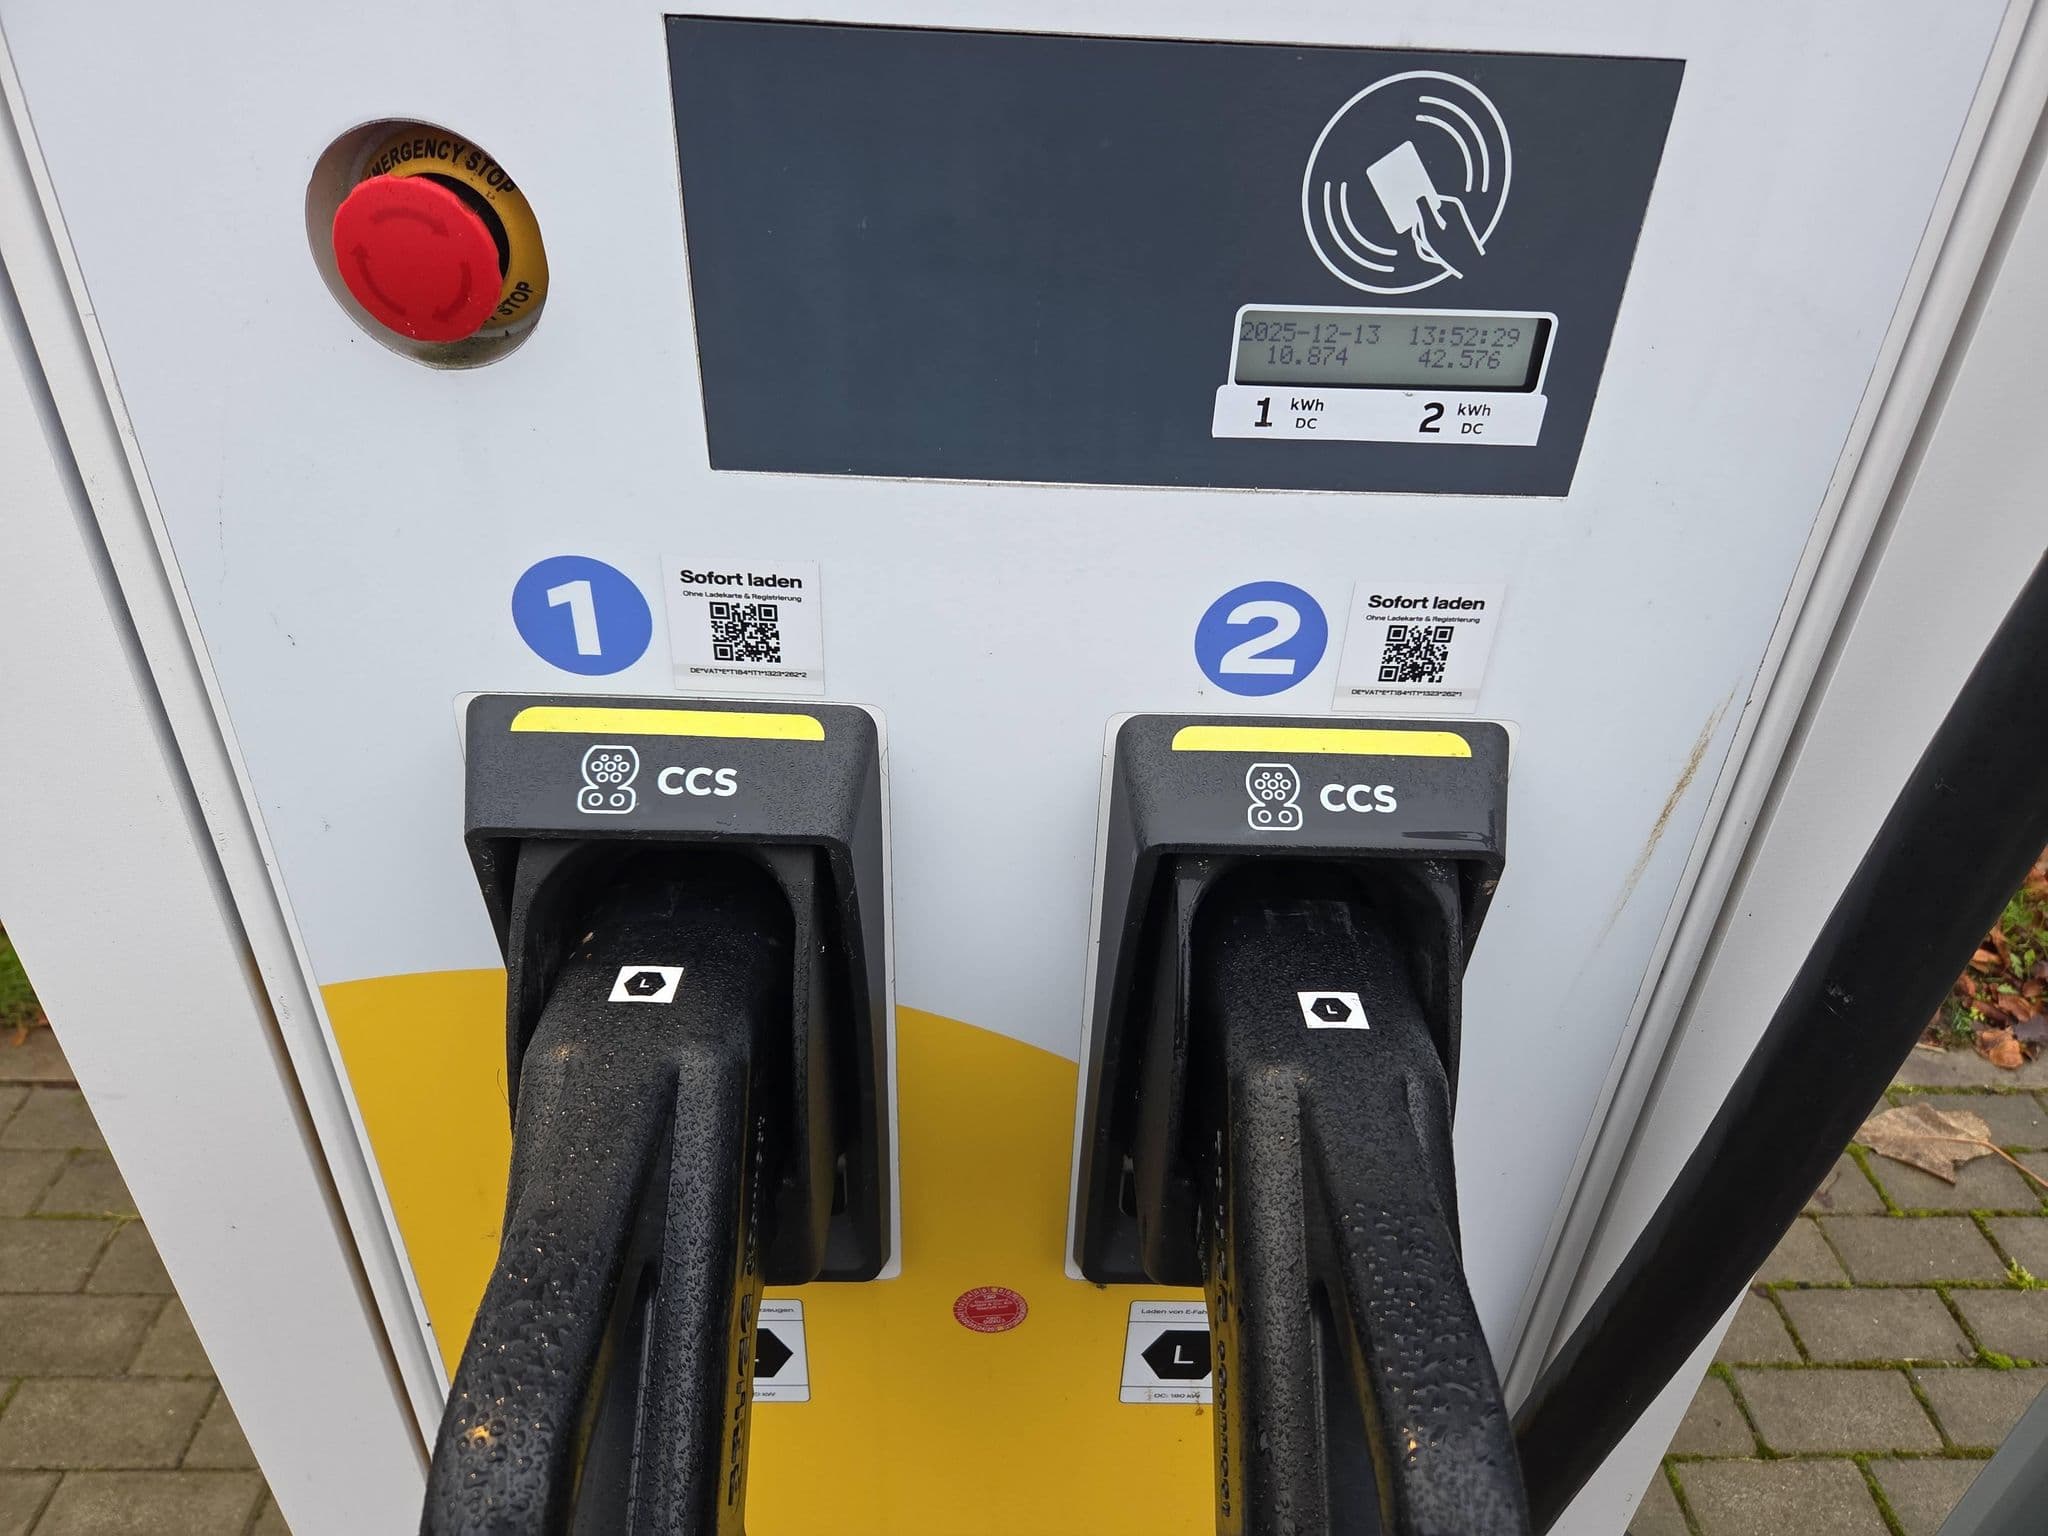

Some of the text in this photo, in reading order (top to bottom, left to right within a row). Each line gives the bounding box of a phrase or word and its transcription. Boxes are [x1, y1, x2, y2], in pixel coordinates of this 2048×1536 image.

[368, 138, 515, 193] MERGENCY STOP
[497, 281, 533, 315] STOP
[1240, 321, 1521, 348] 2025-12-13 13:52:29
[1267, 345, 1501, 369] 10.874 42.576
[1254, 397, 1273, 427] 1
[1290, 398, 1324, 411] kWh
[1457, 403, 1491, 416] kWh
[1295, 418, 1318, 430] DC
[1418, 401, 1445, 433] 2
[1461, 422, 1484, 434] DC
[680, 569, 803, 589] Sofort laden
[704, 591, 743, 599] Ladekarte
[751, 593, 802, 603] Registrierung
[1367, 594, 1485, 611] Sofort laden
[547, 580, 602, 656] 1
[1432, 615, 1481, 624] Registrierung
[1219, 600, 1302, 676] 2
[657, 766, 738, 797] CCS
[1319, 783, 1397, 813] CCS
[639, 978, 650, 988] L
[1325, 1004, 1338, 1014] L
[1173, 1344, 1194, 1365] L
